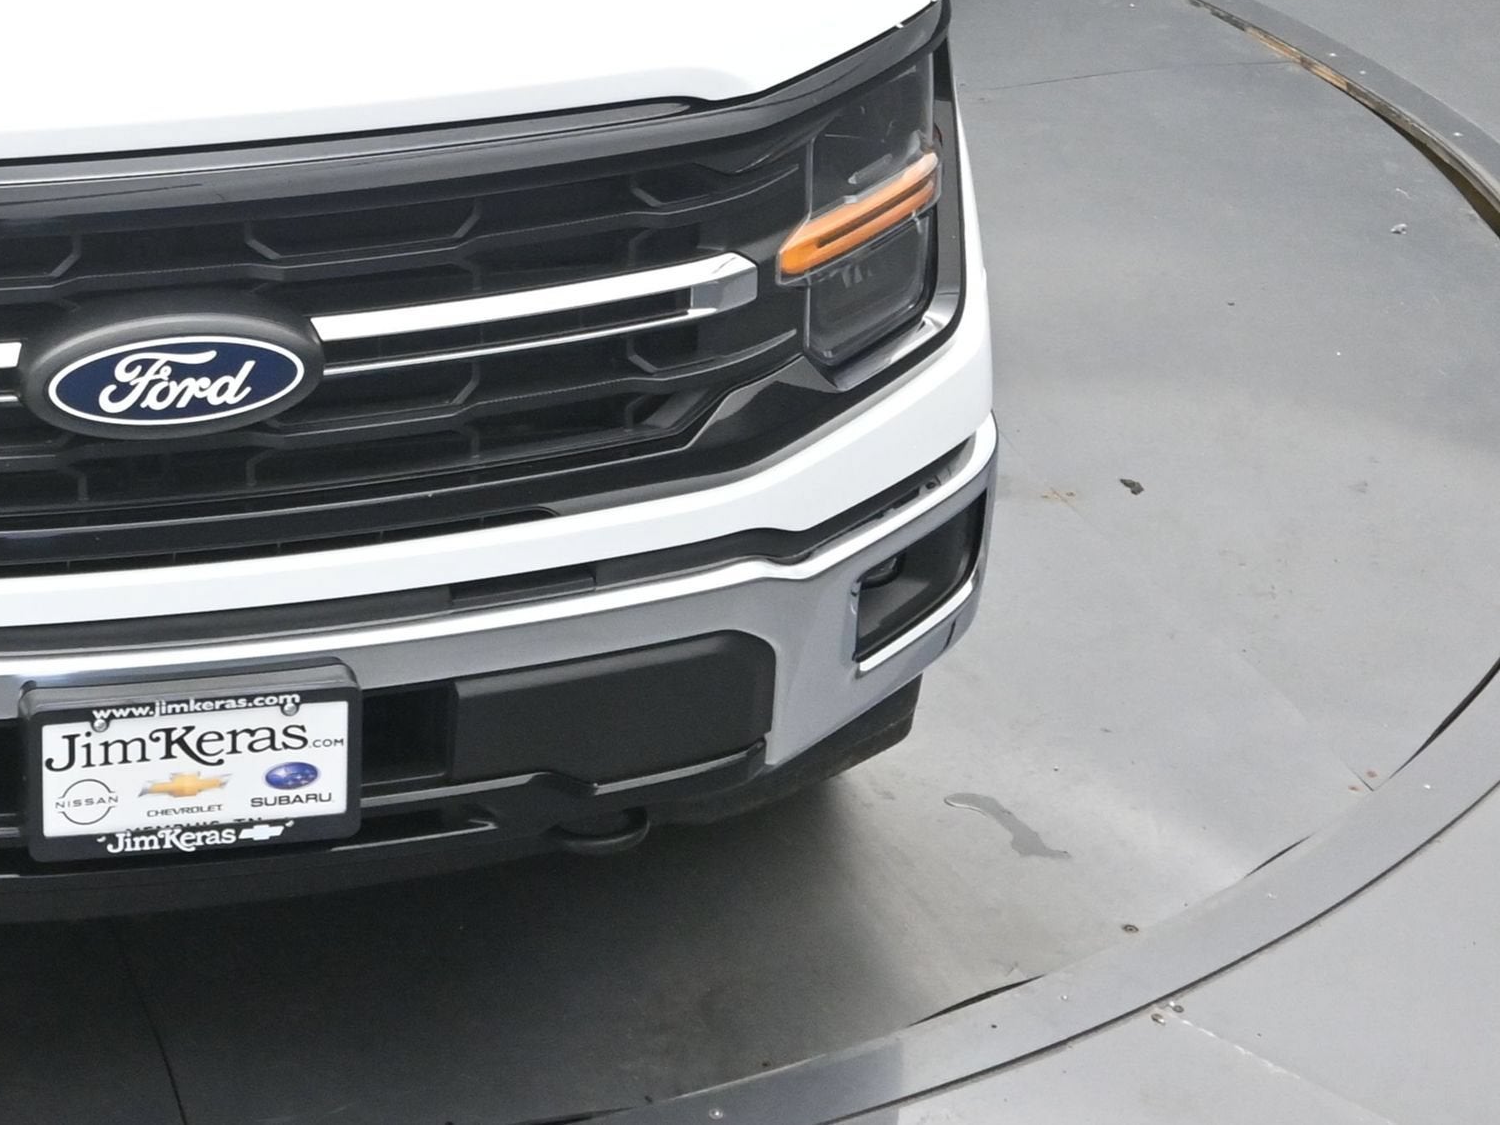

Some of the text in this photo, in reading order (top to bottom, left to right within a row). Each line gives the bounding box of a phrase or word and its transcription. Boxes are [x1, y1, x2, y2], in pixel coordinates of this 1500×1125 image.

[99, 350, 256, 413] Ford
[92, 693, 301, 720] www.jimkeras.com
[55, 794, 119, 809] NISSAN
[250, 792, 332, 808] SUBARU
[146, 804, 224, 818] CHEVROLET
